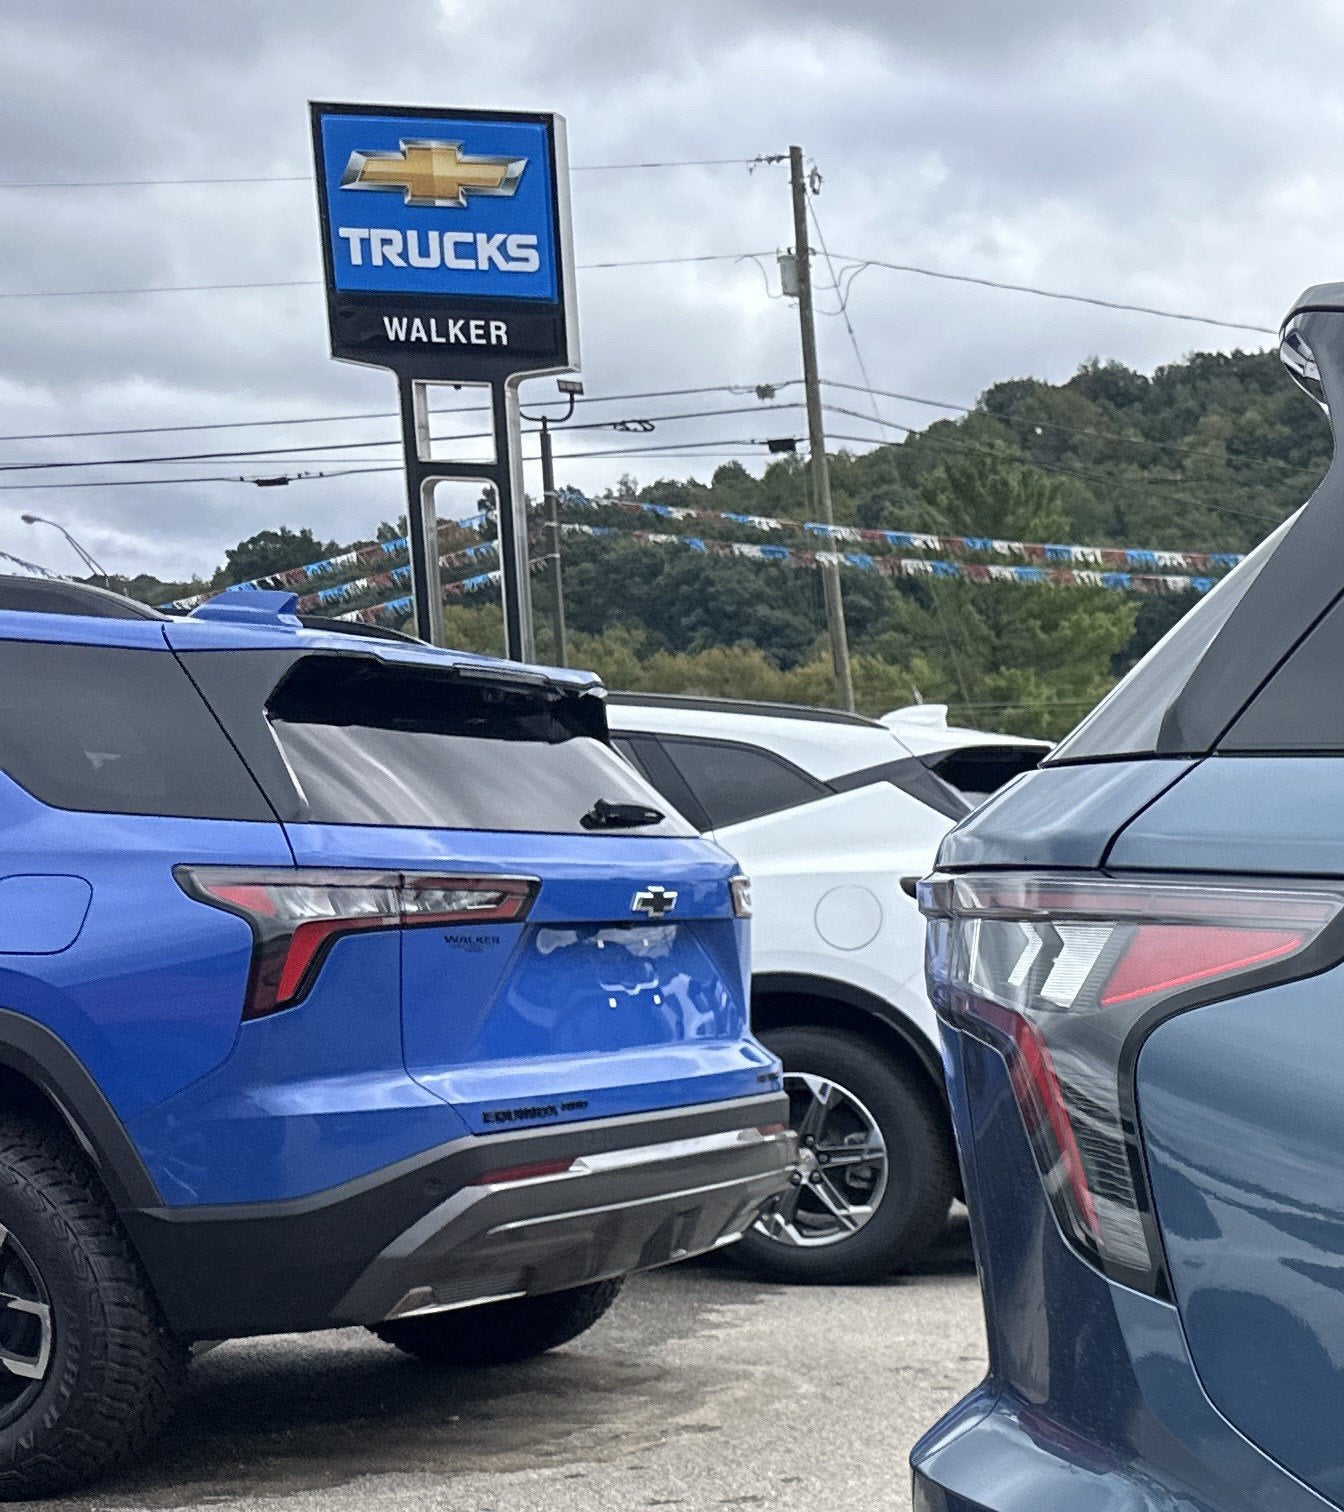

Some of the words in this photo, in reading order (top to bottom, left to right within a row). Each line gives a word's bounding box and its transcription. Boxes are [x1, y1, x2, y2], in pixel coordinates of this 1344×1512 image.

[338, 227, 540, 273] TRUCKS
[382, 316, 509, 346] WALKER
[444, 935, 500, 944] WALKER
